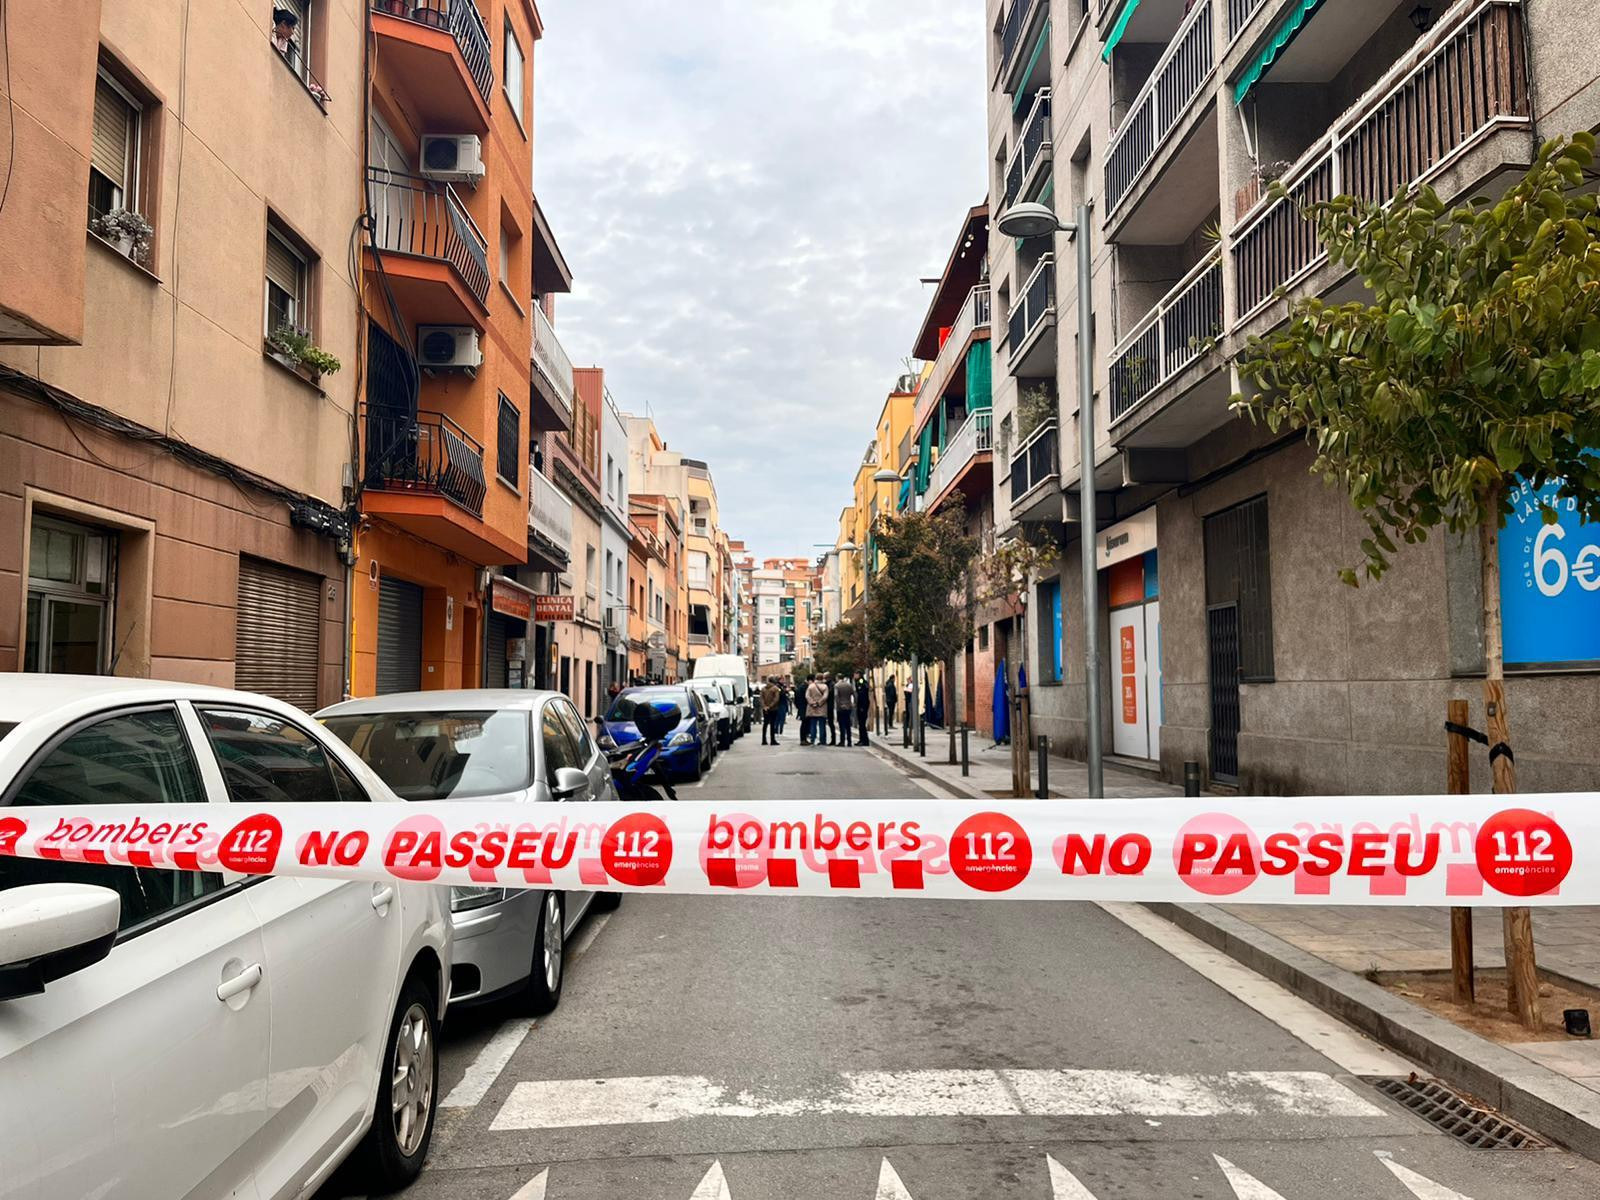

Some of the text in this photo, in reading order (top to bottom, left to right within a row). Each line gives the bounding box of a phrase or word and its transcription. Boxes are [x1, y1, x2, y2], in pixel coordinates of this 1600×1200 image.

[1533, 523, 1600, 597] 6€
[536, 596, 573, 604] CLINICA
[536, 604, 573, 612] DENTAL
[44, 816, 209, 845] bombers
[229, 829, 273, 853] 112
[299, 830, 370, 866] NO
[384, 831, 579, 869] PASSEU
[613, 830, 660, 858] 112
[706, 813, 922, 851] bombers
[964, 831, 1016, 861] 112
[1061, 832, 1153, 876] NO
[1178, 832, 1440, 877] PASSEU
[1491, 829, 1555, 862] 112
